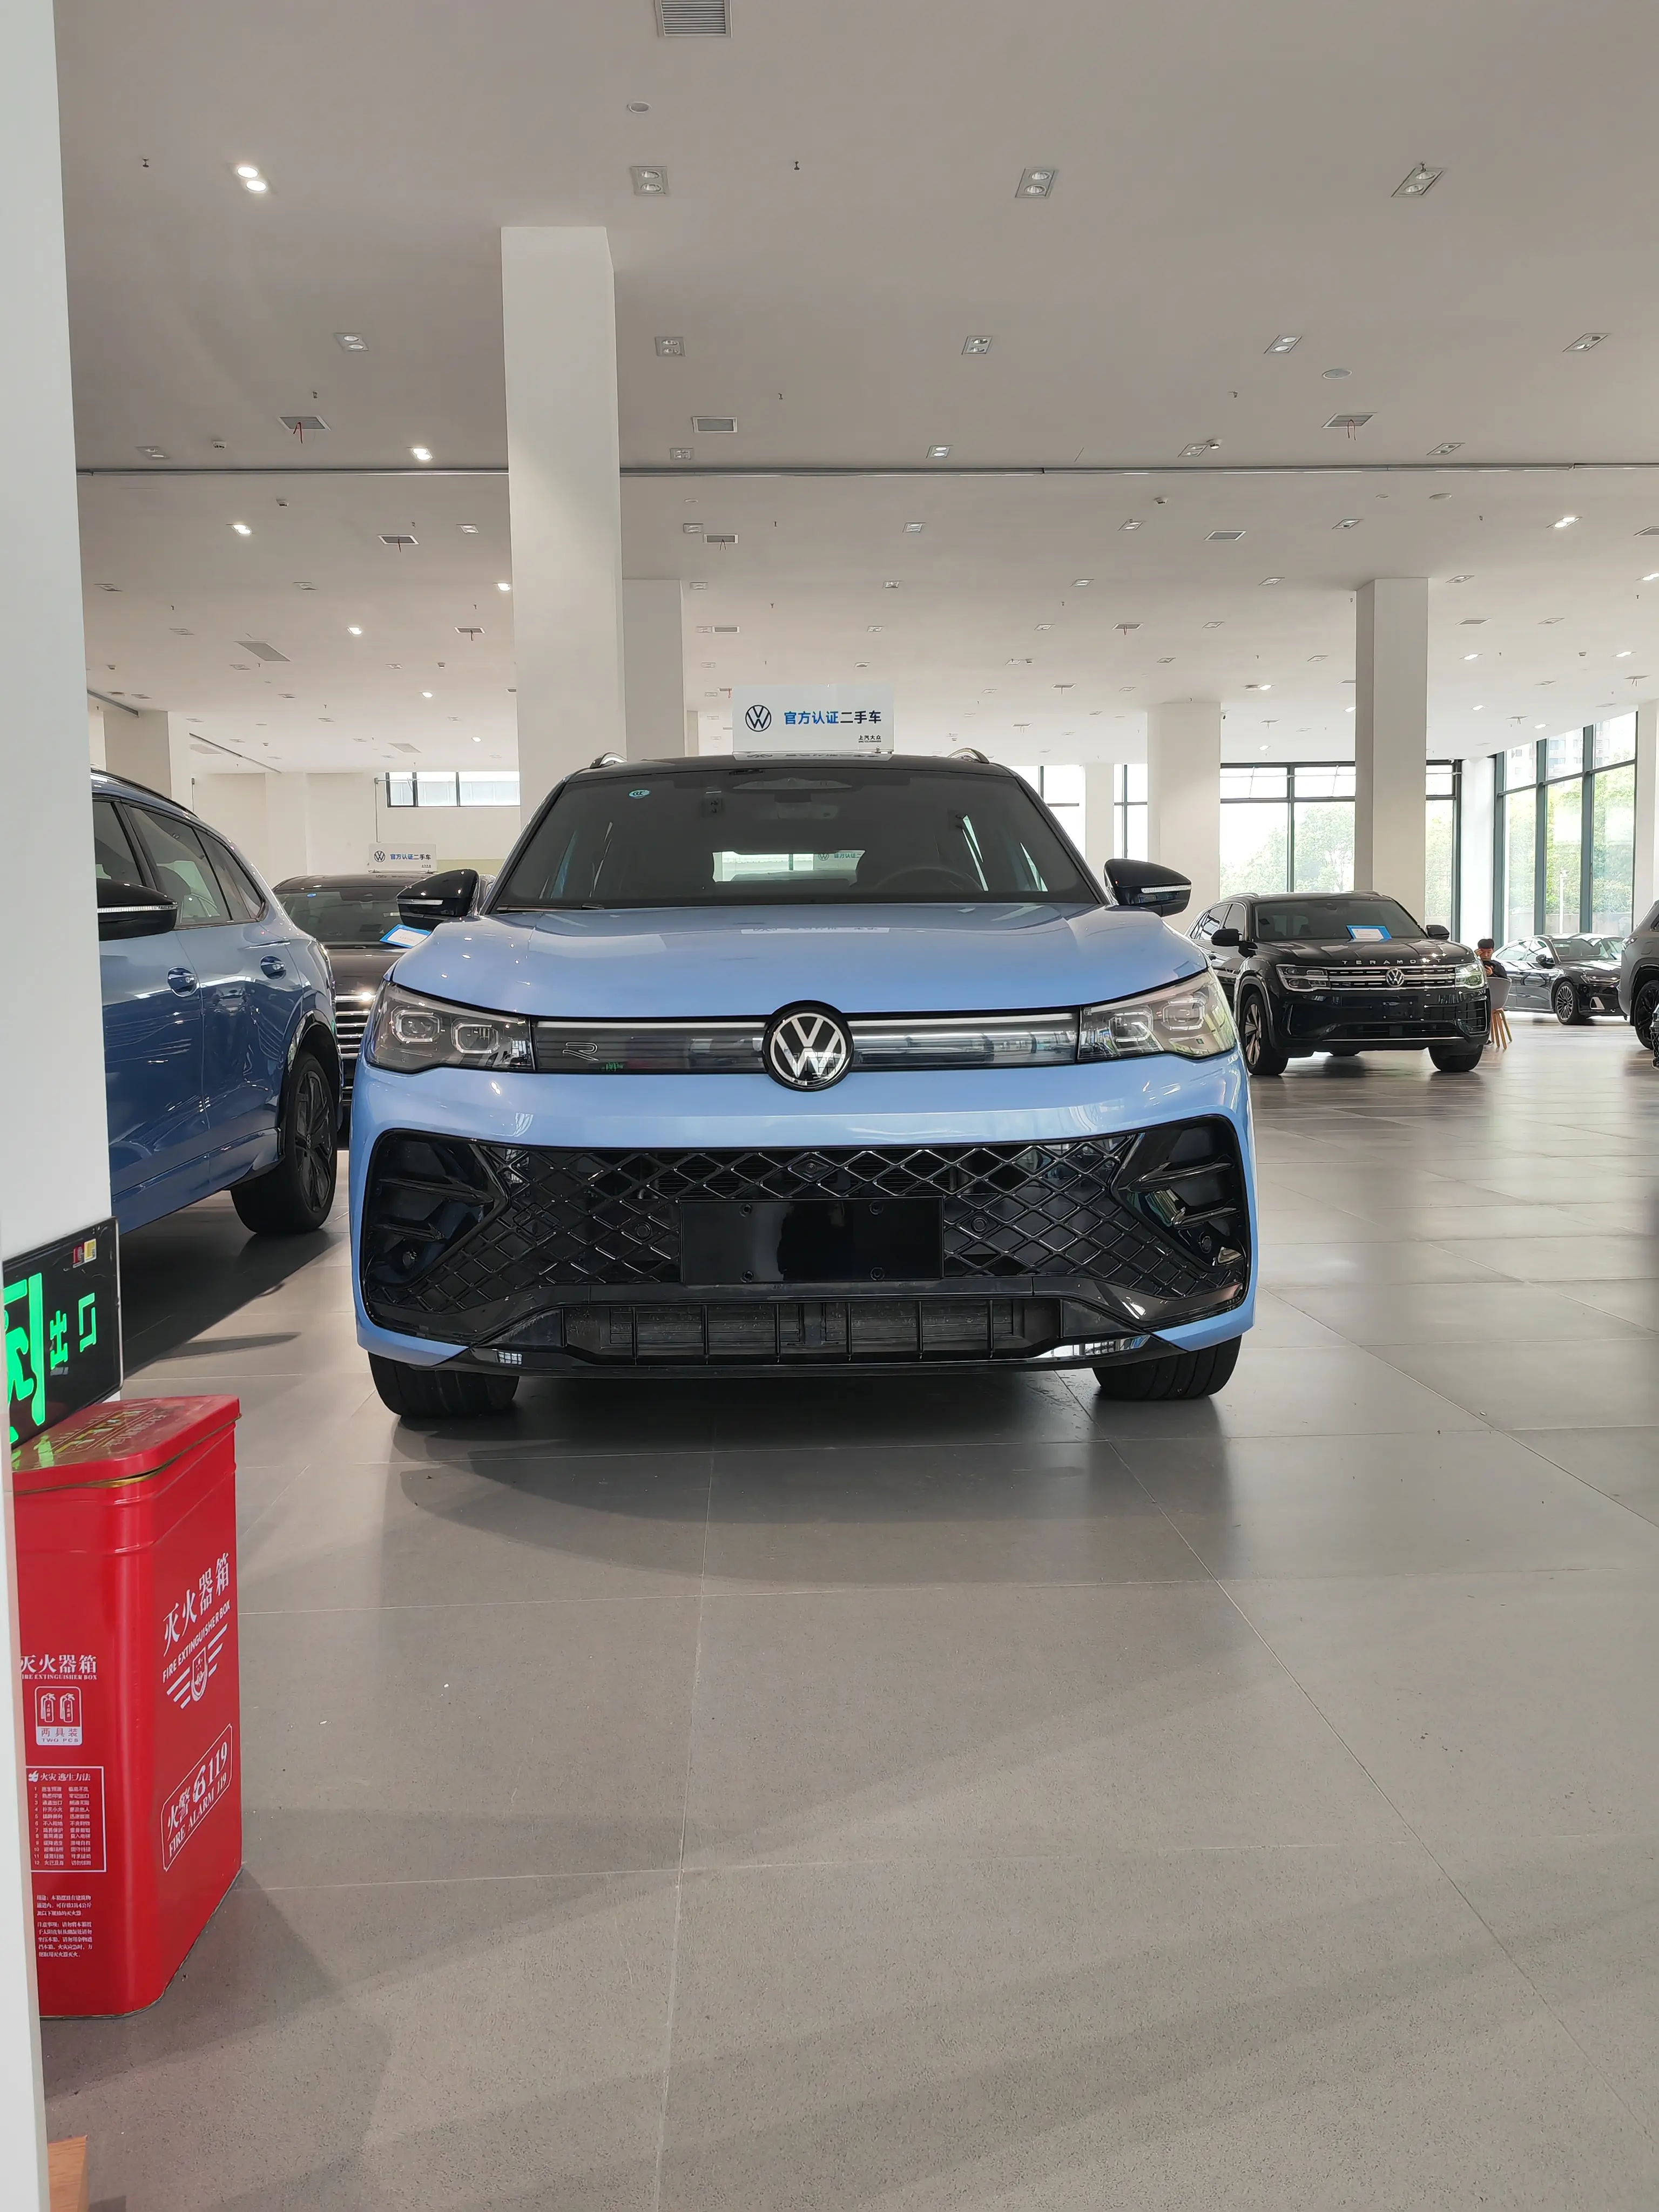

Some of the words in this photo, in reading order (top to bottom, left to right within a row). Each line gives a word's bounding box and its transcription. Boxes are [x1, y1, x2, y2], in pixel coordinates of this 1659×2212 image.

[784, 710, 882, 725] 官方认证二手车
[50, 1292, 97, 1370] 出口
[163, 1553, 229, 1657] 灭火器箱
[163, 1658, 177, 1683] FIRE
[178, 1614, 219, 1667] EXTINGUISHER
[219, 1599, 231, 1620] BOX
[21, 1654, 97, 1674] 灭火器箱
[41, 1728, 78, 1737] 两具装
[167, 1785, 191, 1841] 火警
[208, 1741, 228, 1787] 119
[169, 1824, 186, 1859] FIRE
[188, 1788, 214, 1832] ALARM
[217, 1771, 227, 1796] 119
